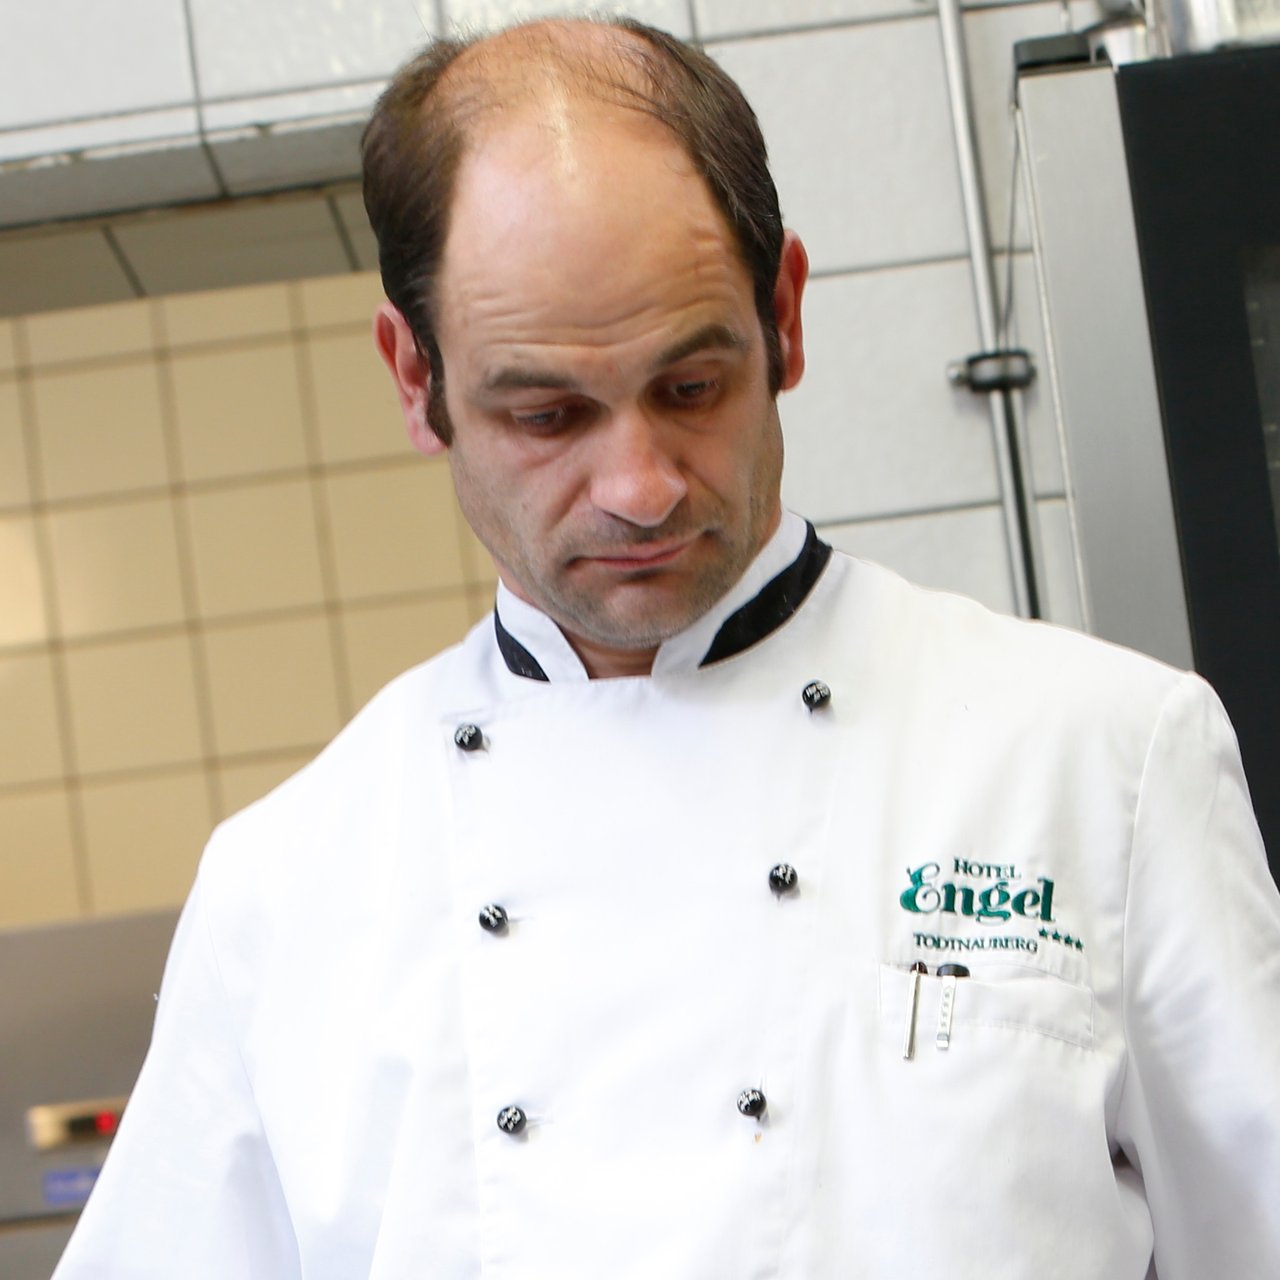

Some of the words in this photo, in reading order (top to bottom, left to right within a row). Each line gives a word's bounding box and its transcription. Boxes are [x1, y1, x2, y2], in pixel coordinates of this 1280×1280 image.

[953, 857, 1022, 879] HOTEL
[899, 862, 1056, 925] Engel
[913, 932, 1039, 953] TODTNAUBERG
